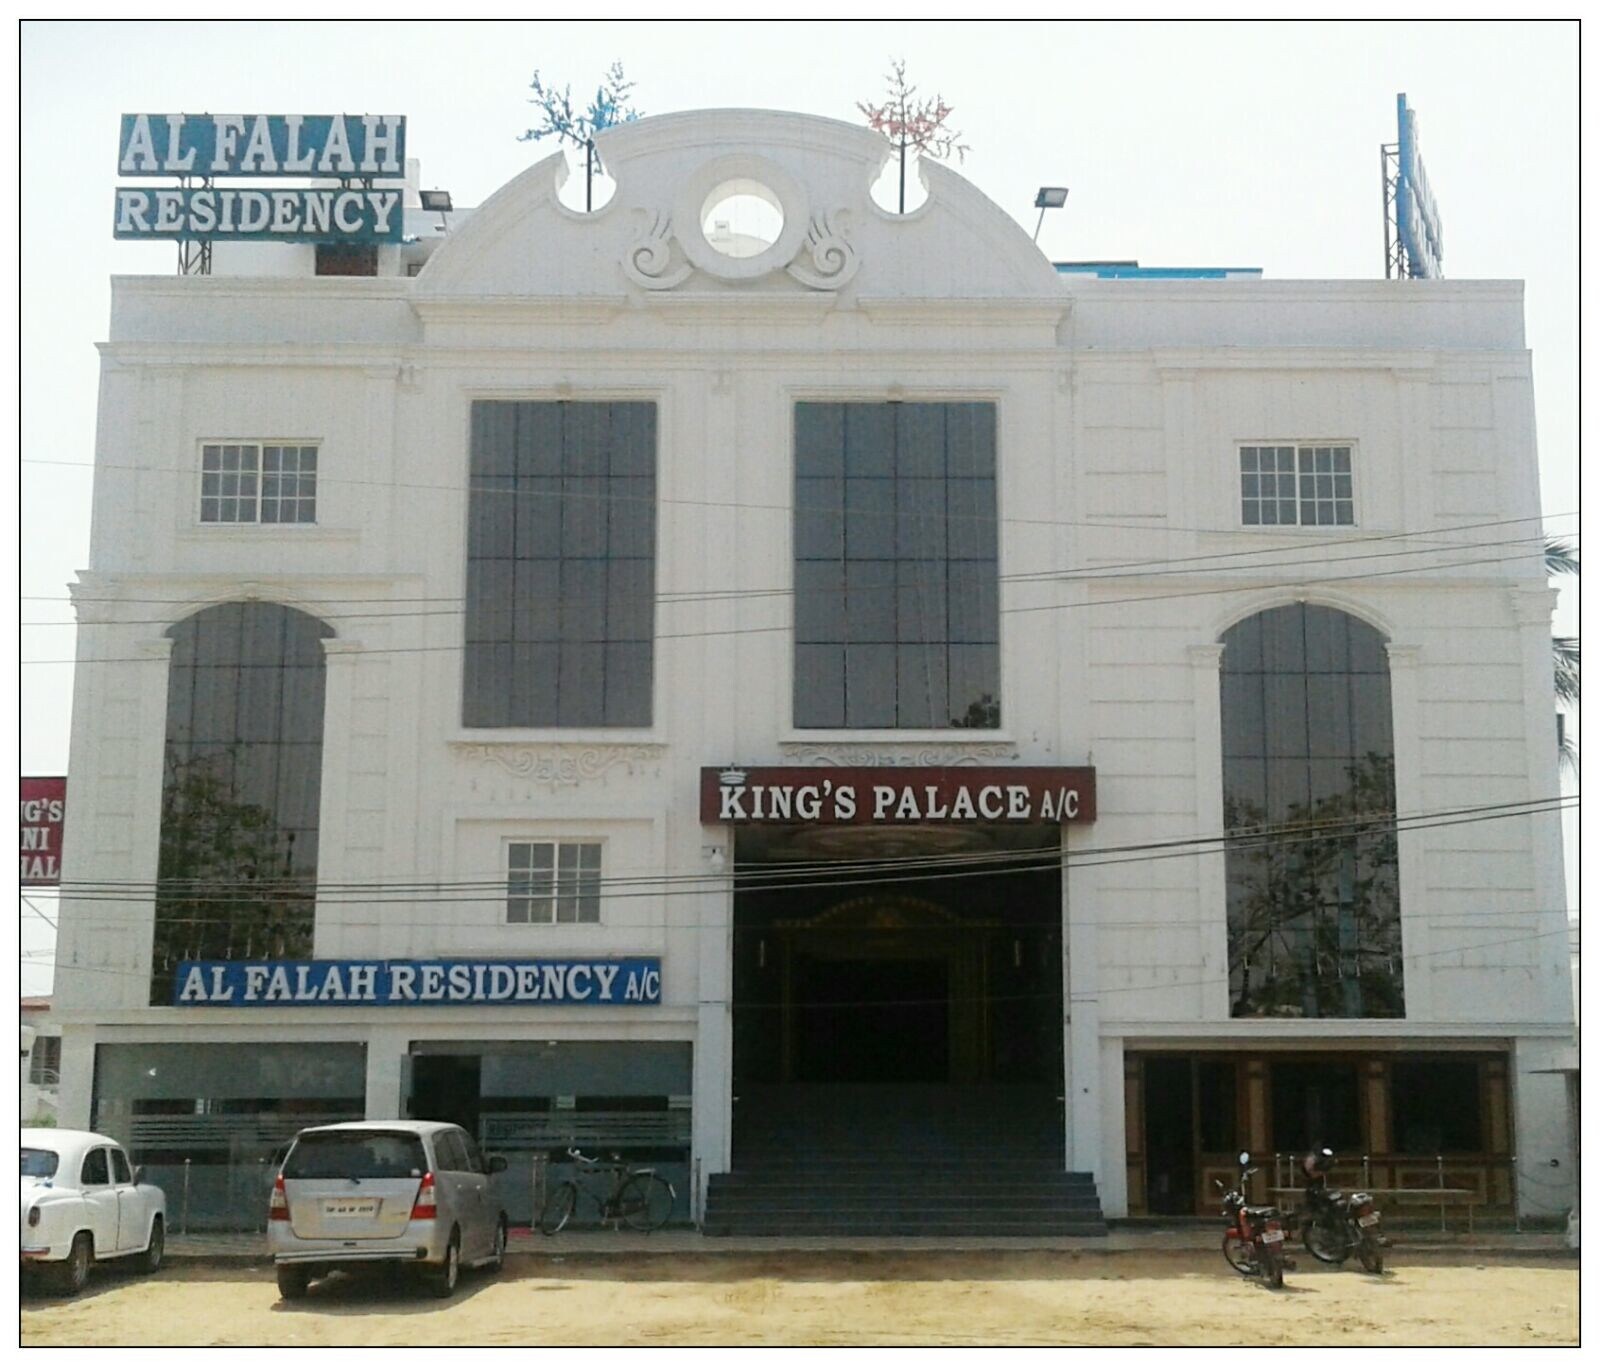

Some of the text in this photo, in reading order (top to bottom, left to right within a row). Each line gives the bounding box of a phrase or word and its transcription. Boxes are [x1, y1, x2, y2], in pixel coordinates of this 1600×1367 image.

[121, 115, 402, 172] AL FALAH
[117, 191, 398, 233] RESIDENCY
[21, 798, 63, 822] G'S
[719, 779, 1079, 822] KING'S PALACE A/C
[180, 965, 659, 1001] AL FALAH RESIDENCY A/C
